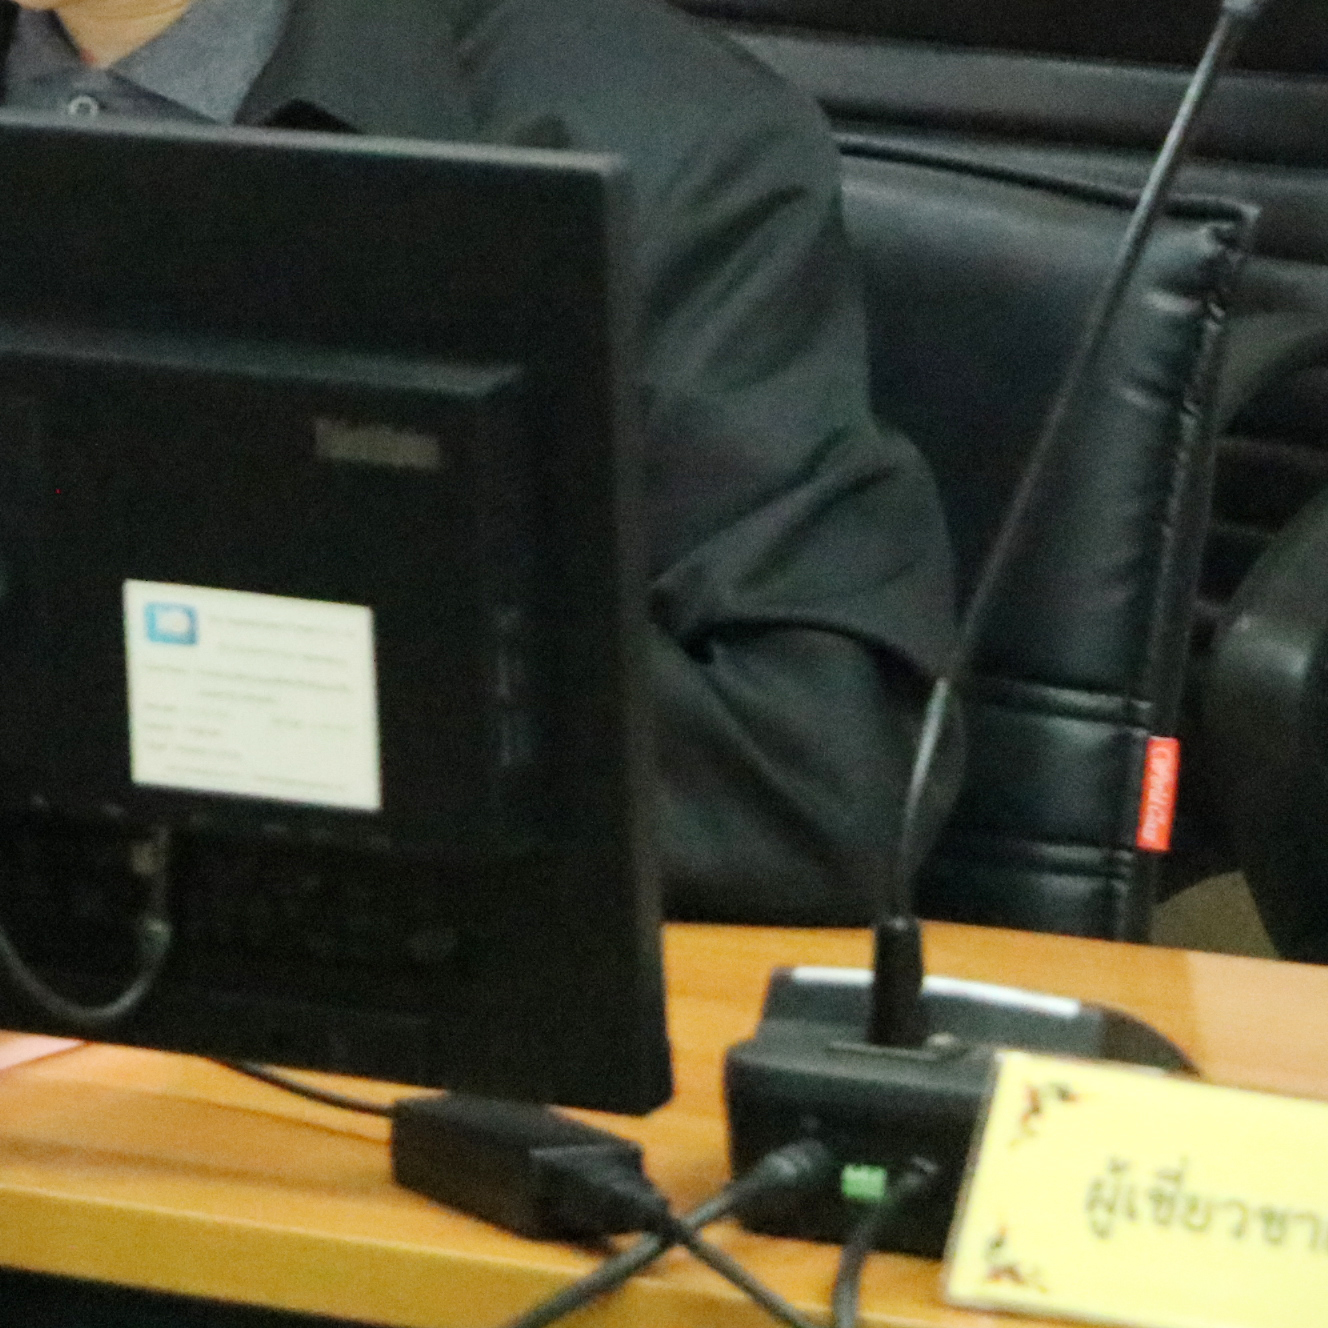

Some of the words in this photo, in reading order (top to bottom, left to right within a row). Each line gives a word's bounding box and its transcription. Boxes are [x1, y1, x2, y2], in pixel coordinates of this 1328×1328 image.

[1085, 1155, 1328, 1256] ผู้เชี่ยวชา
